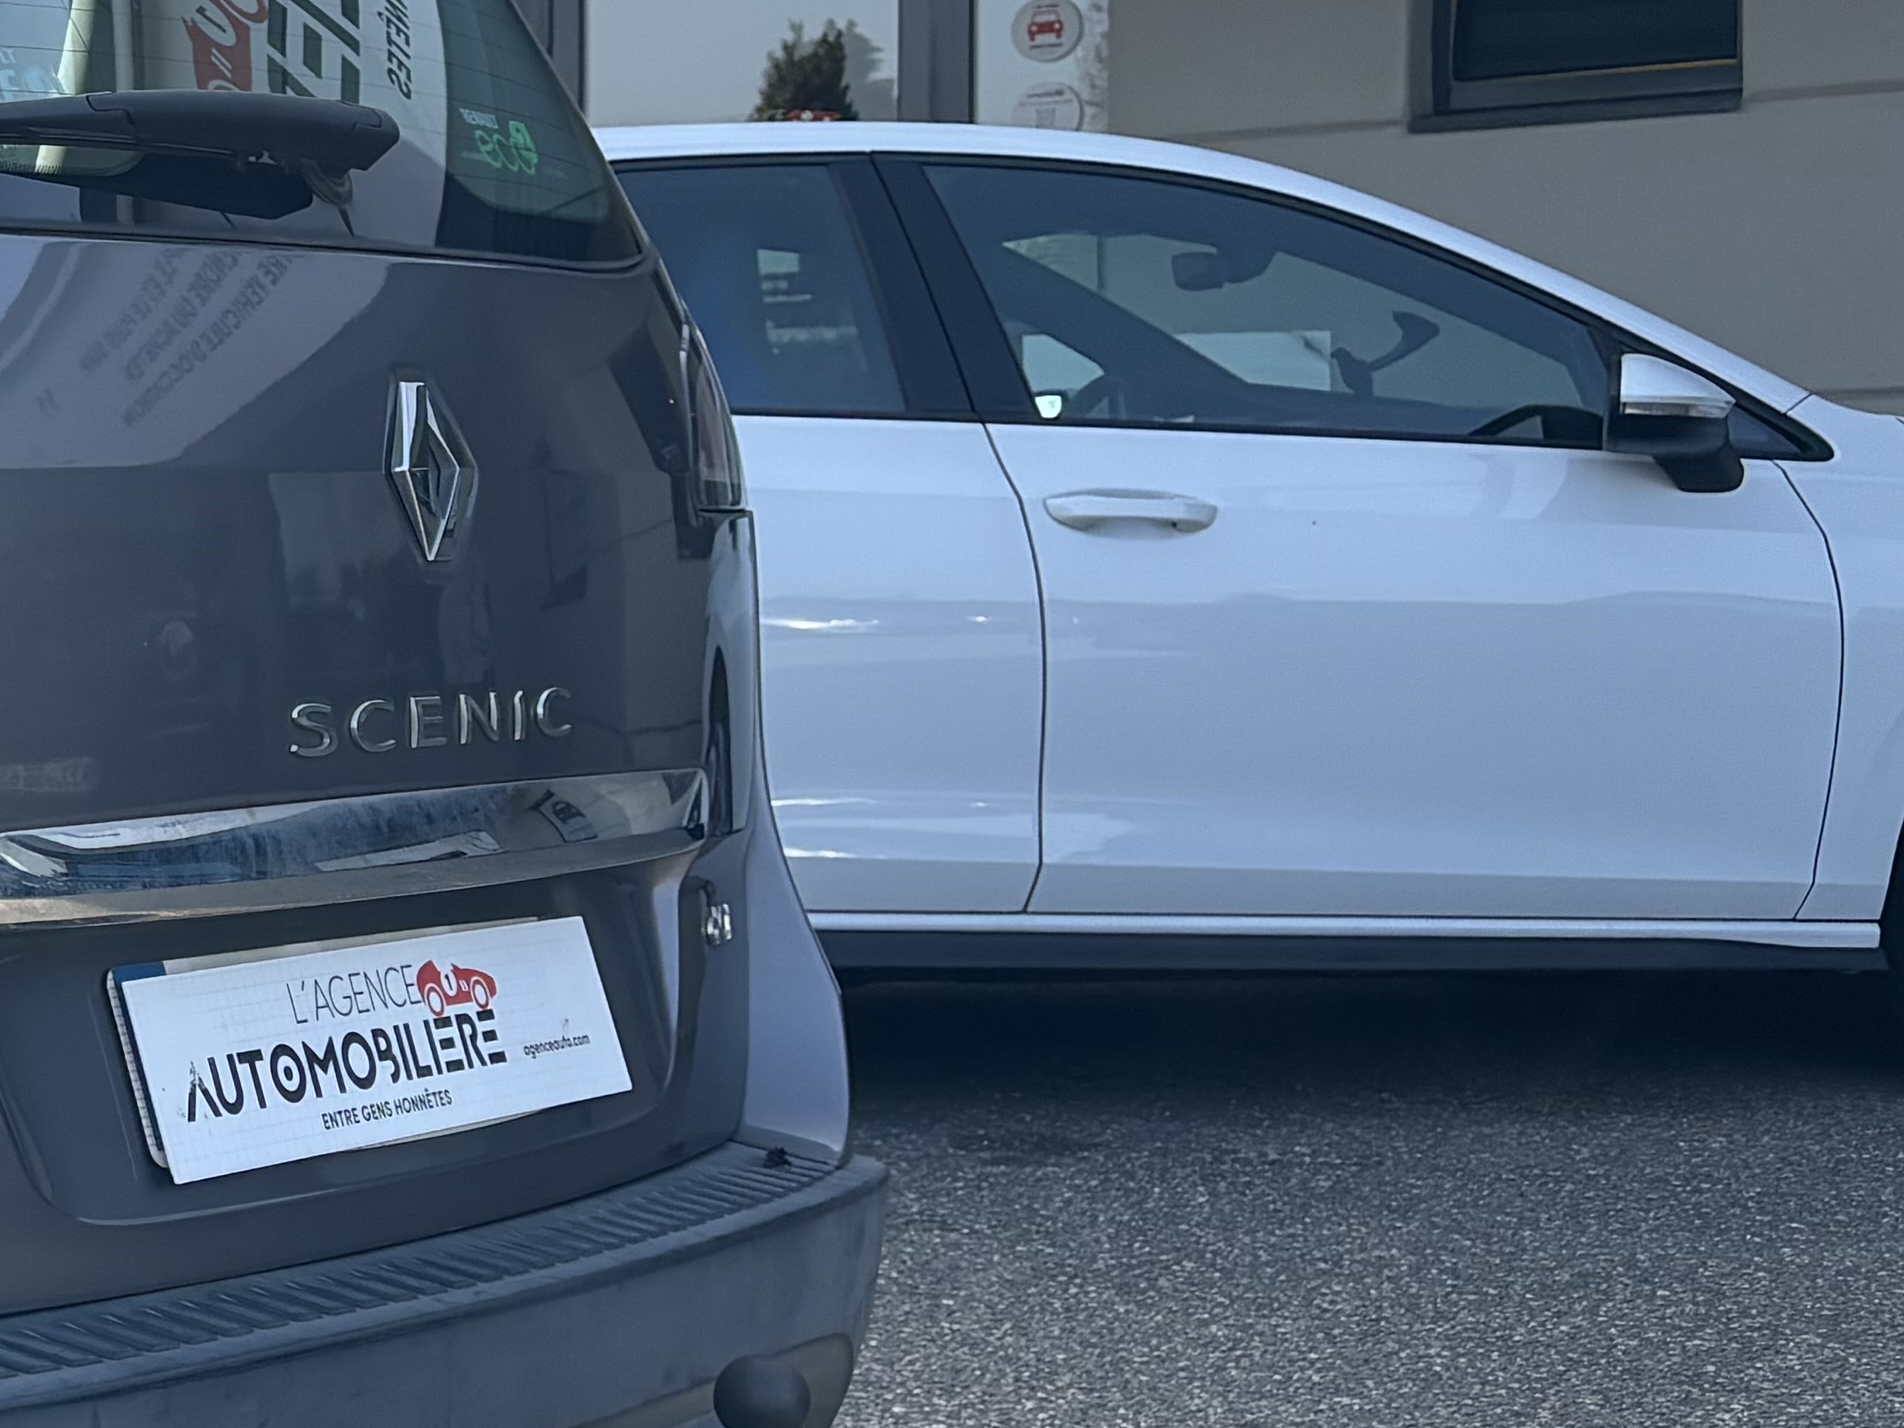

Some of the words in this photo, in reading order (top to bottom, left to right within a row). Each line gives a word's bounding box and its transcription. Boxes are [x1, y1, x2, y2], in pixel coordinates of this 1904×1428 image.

[290, 687, 574, 758] SCENIC
[286, 963, 423, 1025] L'AGENCE
[321, 1106, 359, 1131] ENTRE
[360, 1098, 394, 1123] GENS
[395, 1087, 454, 1116] HONNÊTES
